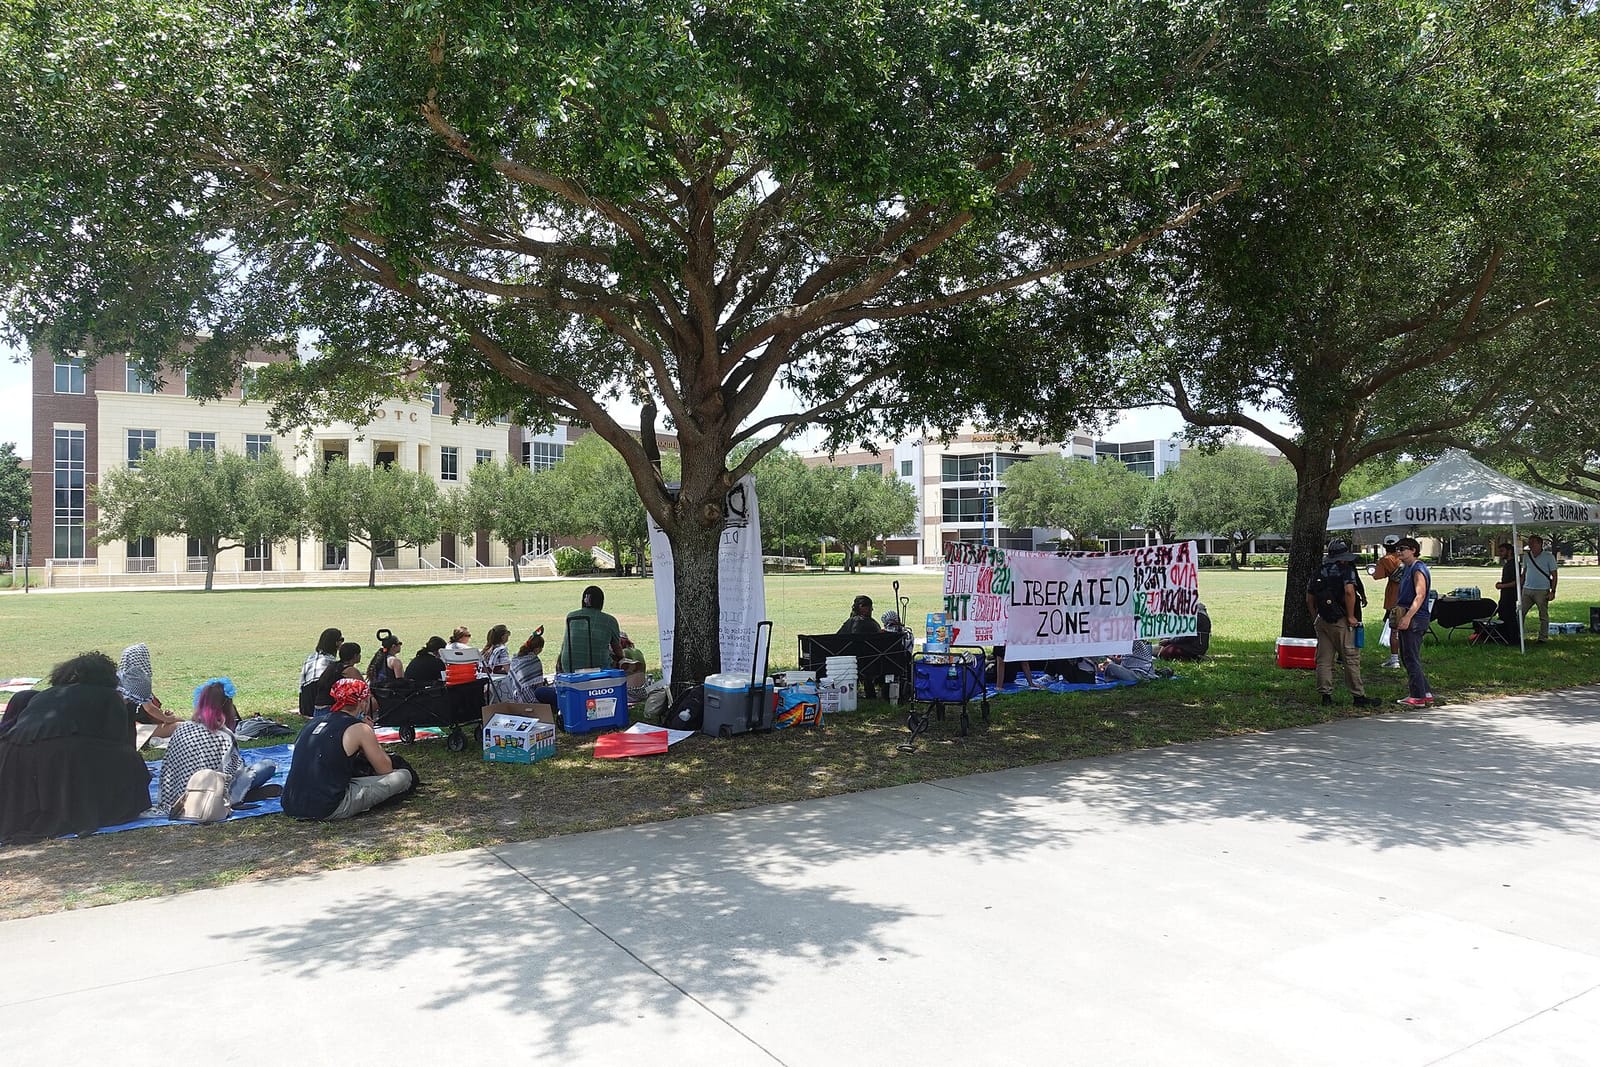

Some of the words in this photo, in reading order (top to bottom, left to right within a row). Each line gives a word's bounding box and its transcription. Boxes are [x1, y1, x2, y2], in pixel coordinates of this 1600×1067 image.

[375, 408, 418, 423] OTC
[1353, 509, 1393, 525] FREE
[1405, 507, 1473, 522] QURANS
[1532, 505, 1555, 521] FREE
[1558, 506, 1589, 521] QURANS
[1011, 576, 1130, 607] LIBERATED
[1036, 609, 1092, 637] ZONE
[588, 687, 614, 697] IGLOO
